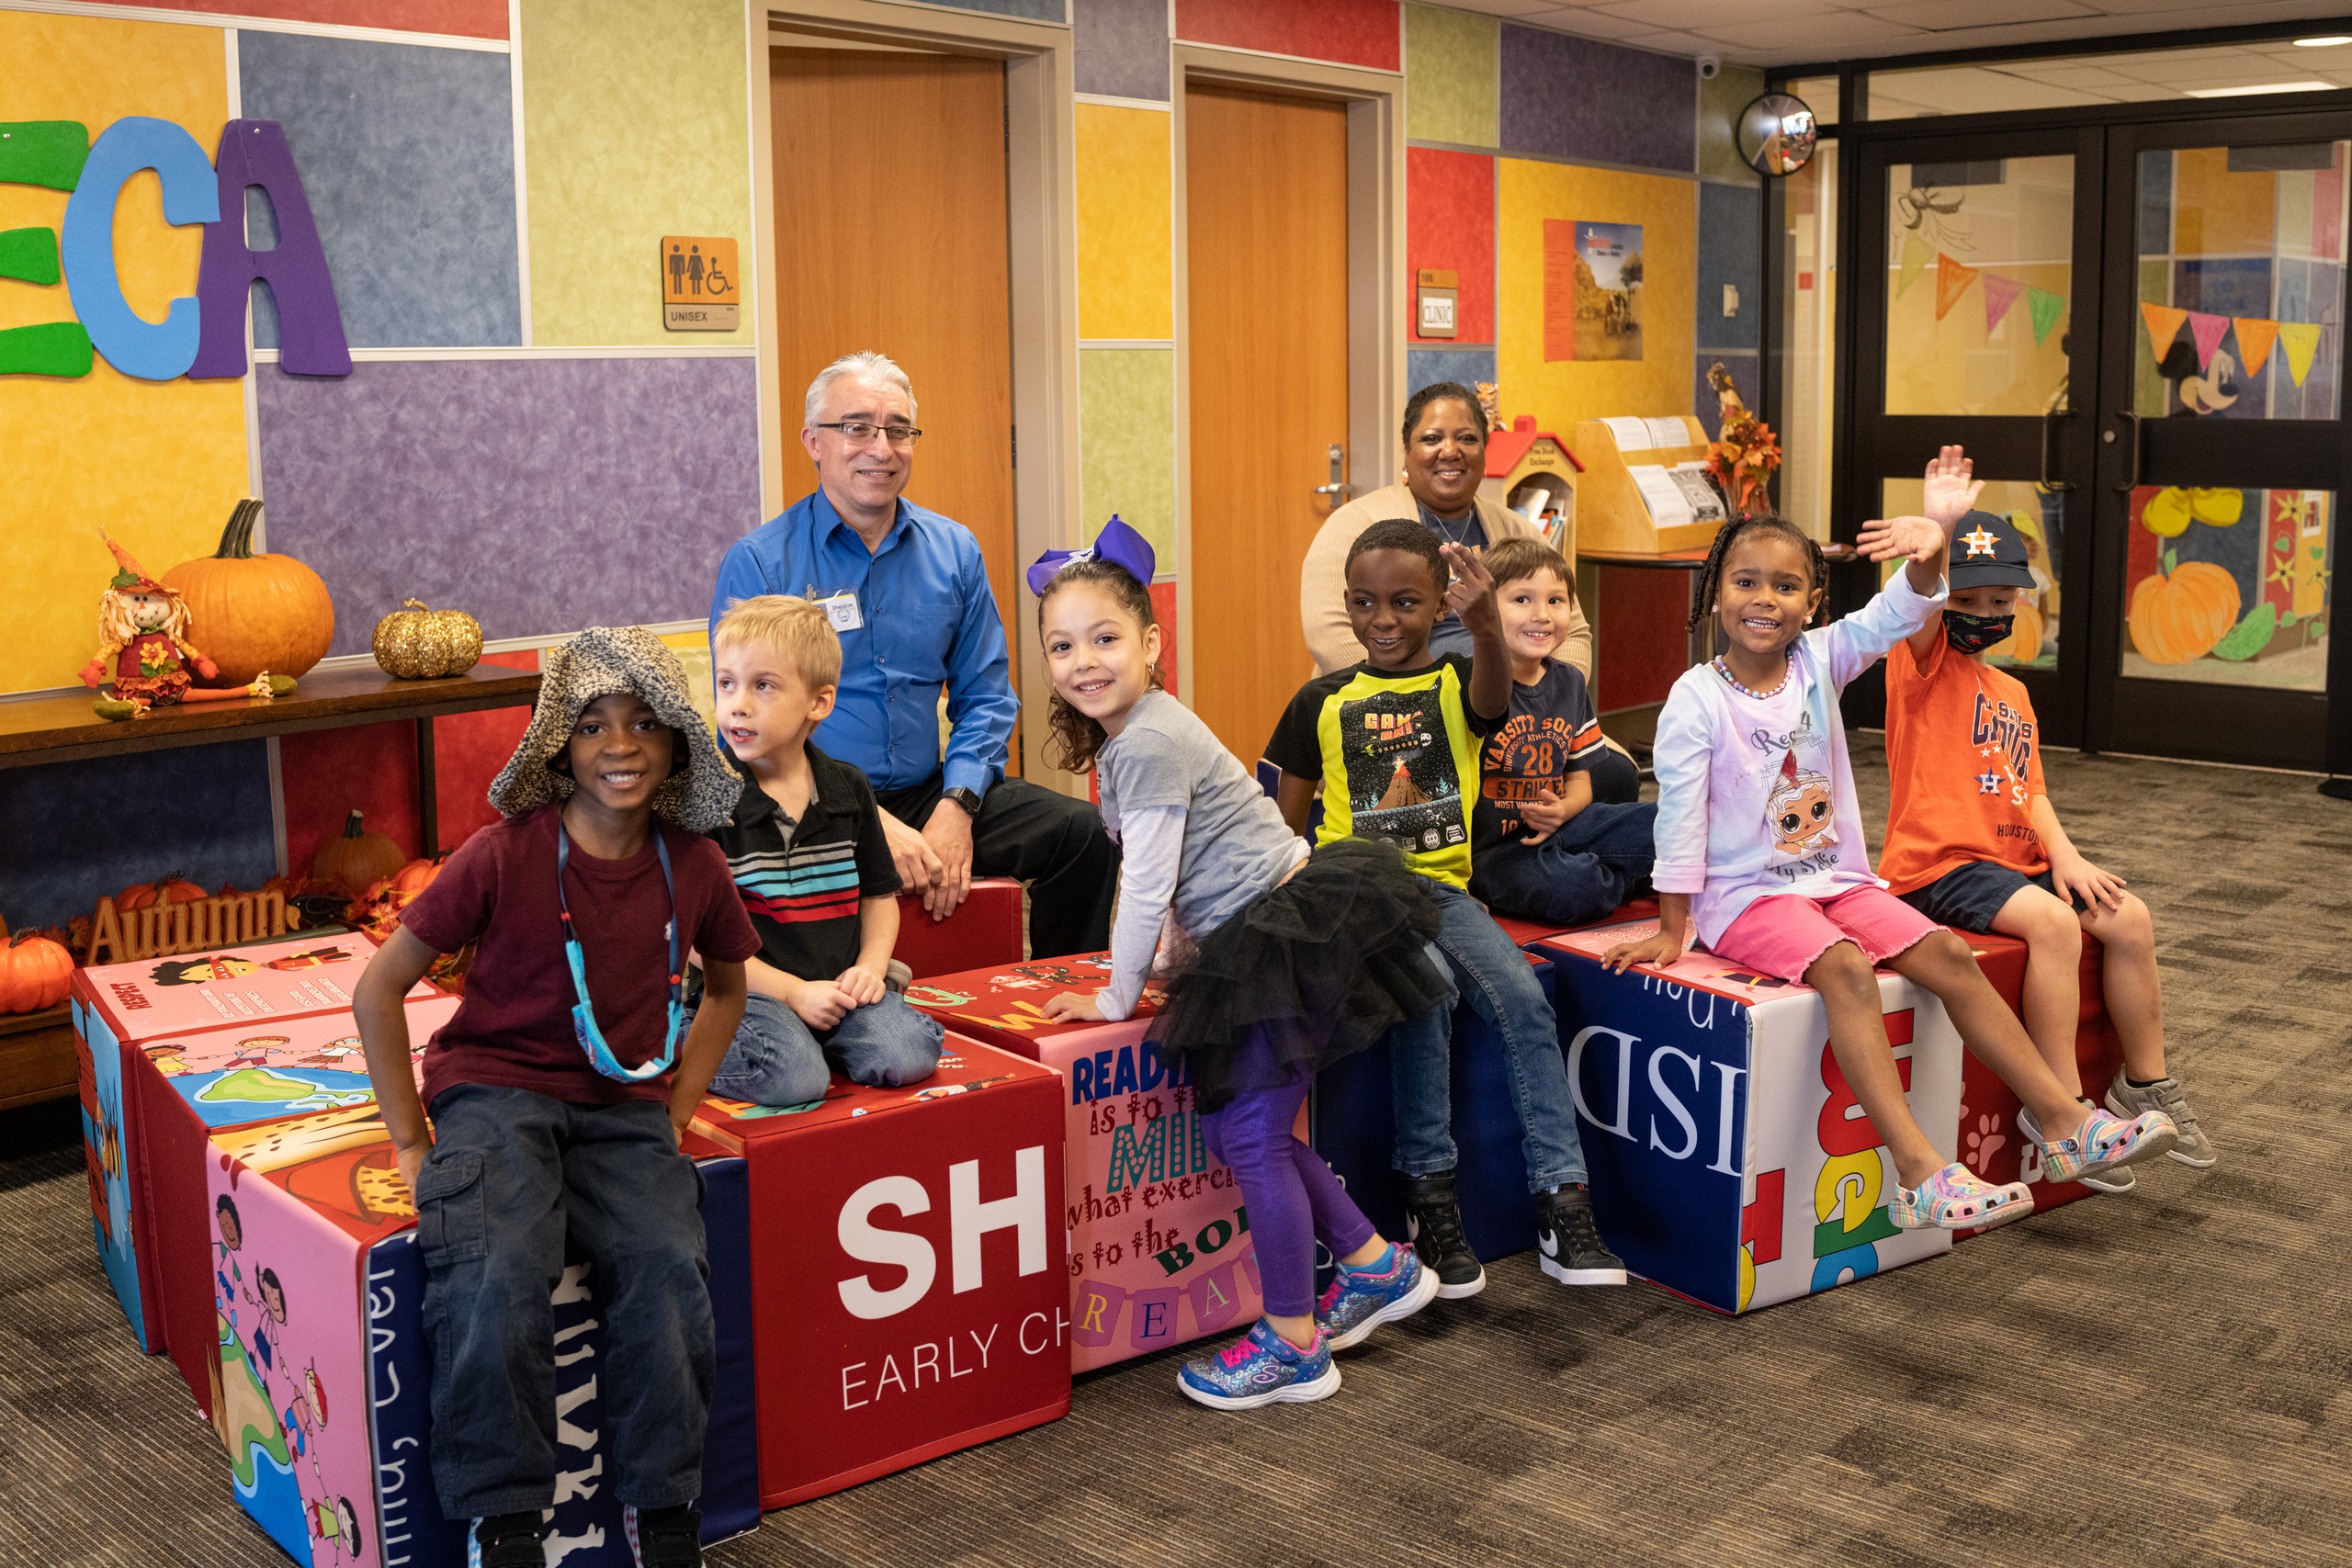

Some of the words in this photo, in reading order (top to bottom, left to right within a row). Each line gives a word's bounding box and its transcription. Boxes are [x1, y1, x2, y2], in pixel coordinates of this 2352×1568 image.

[671, 311, 707, 321] UNISEX
[1423, 305, 1452, 324] CLINIC
[1530, 457, 1555, 467] Exchange
[1484, 715, 1534, 771] VARSITY
[1503, 736, 1526, 772] UNIVERSITY
[1527, 730, 1566, 750] ATHLETICS
[1521, 741, 1553, 776] 28
[1494, 800, 1514, 809] MOST
[87, 887, 286, 966] Autumn
[109, 982, 153, 1010] RESPECT
[1090, 1098, 1115, 1135] is
[1127, 1093, 1163, 1126] to
[838, 1145, 1047, 1320] SH
[1092, 1233, 1124, 1269] to
[1131, 1217, 1181, 1259] the
[842, 1324, 999, 1411] EARLY
